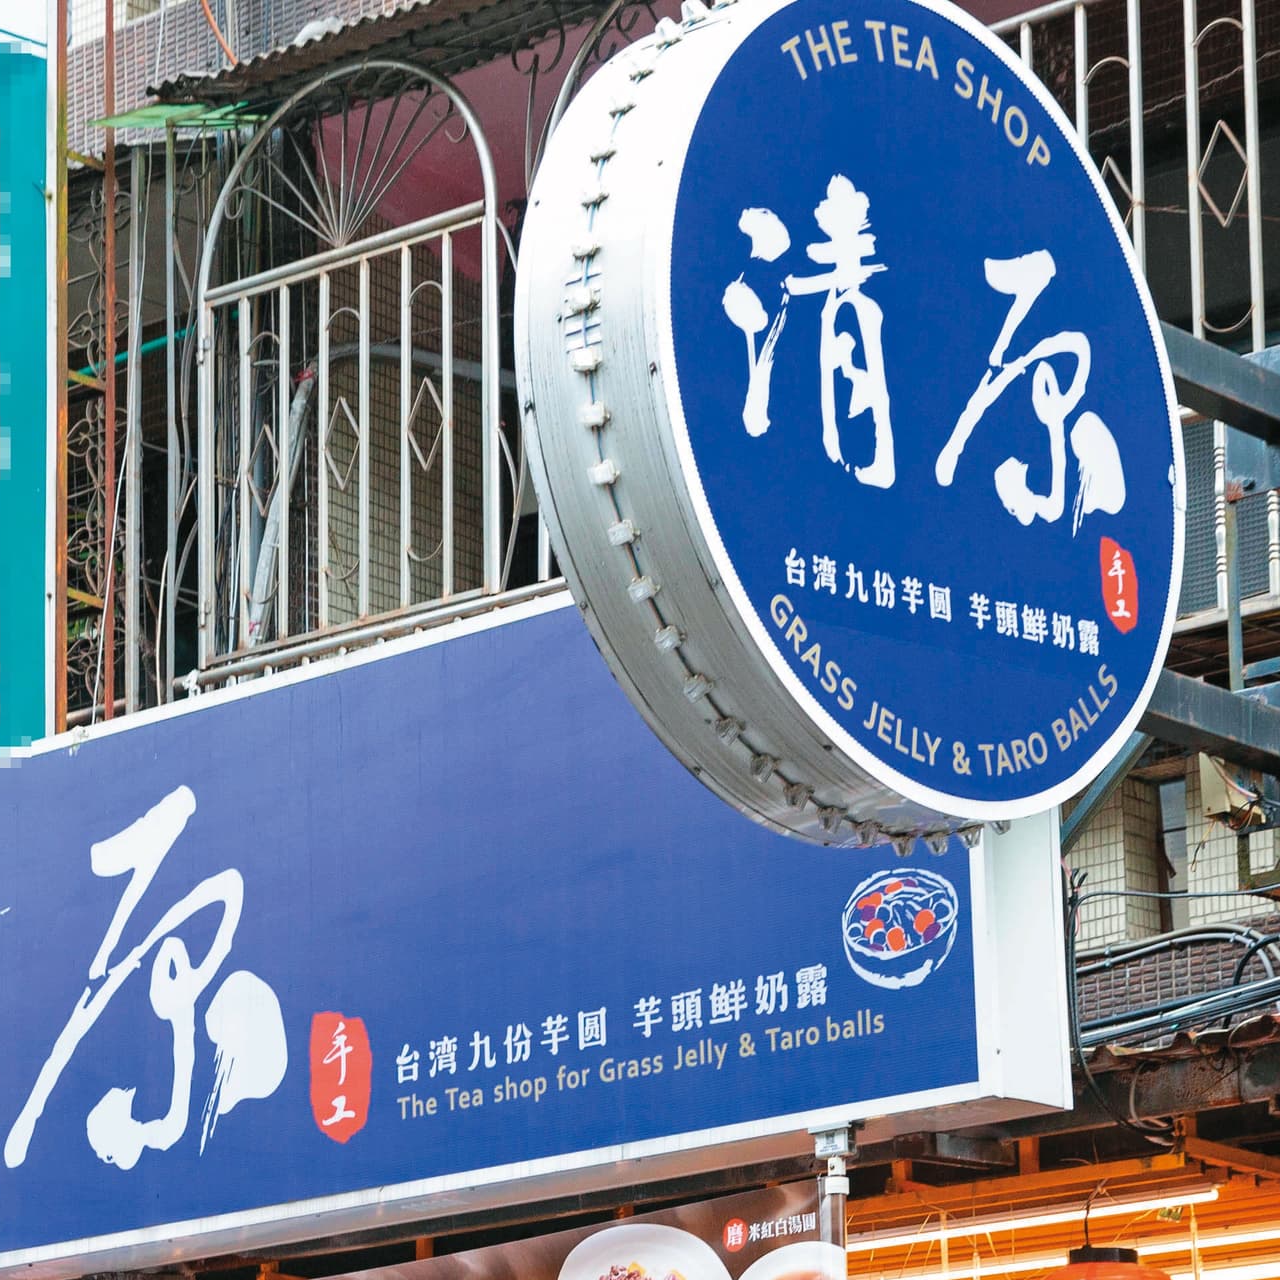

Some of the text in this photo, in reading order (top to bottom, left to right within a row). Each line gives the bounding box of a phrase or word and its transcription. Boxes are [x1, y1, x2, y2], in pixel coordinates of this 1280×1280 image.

[781, 20, 1052, 169] THE TEA SHOP
[1108, 551, 1131, 618] 手工
[770, 593, 1119, 777] GRASS JELLY & TARO BALLS
[322, 1021, 356, 1127] 手工
[397, 1009, 885, 1121] The Tea shop for Grass Jelly & Taro balls
